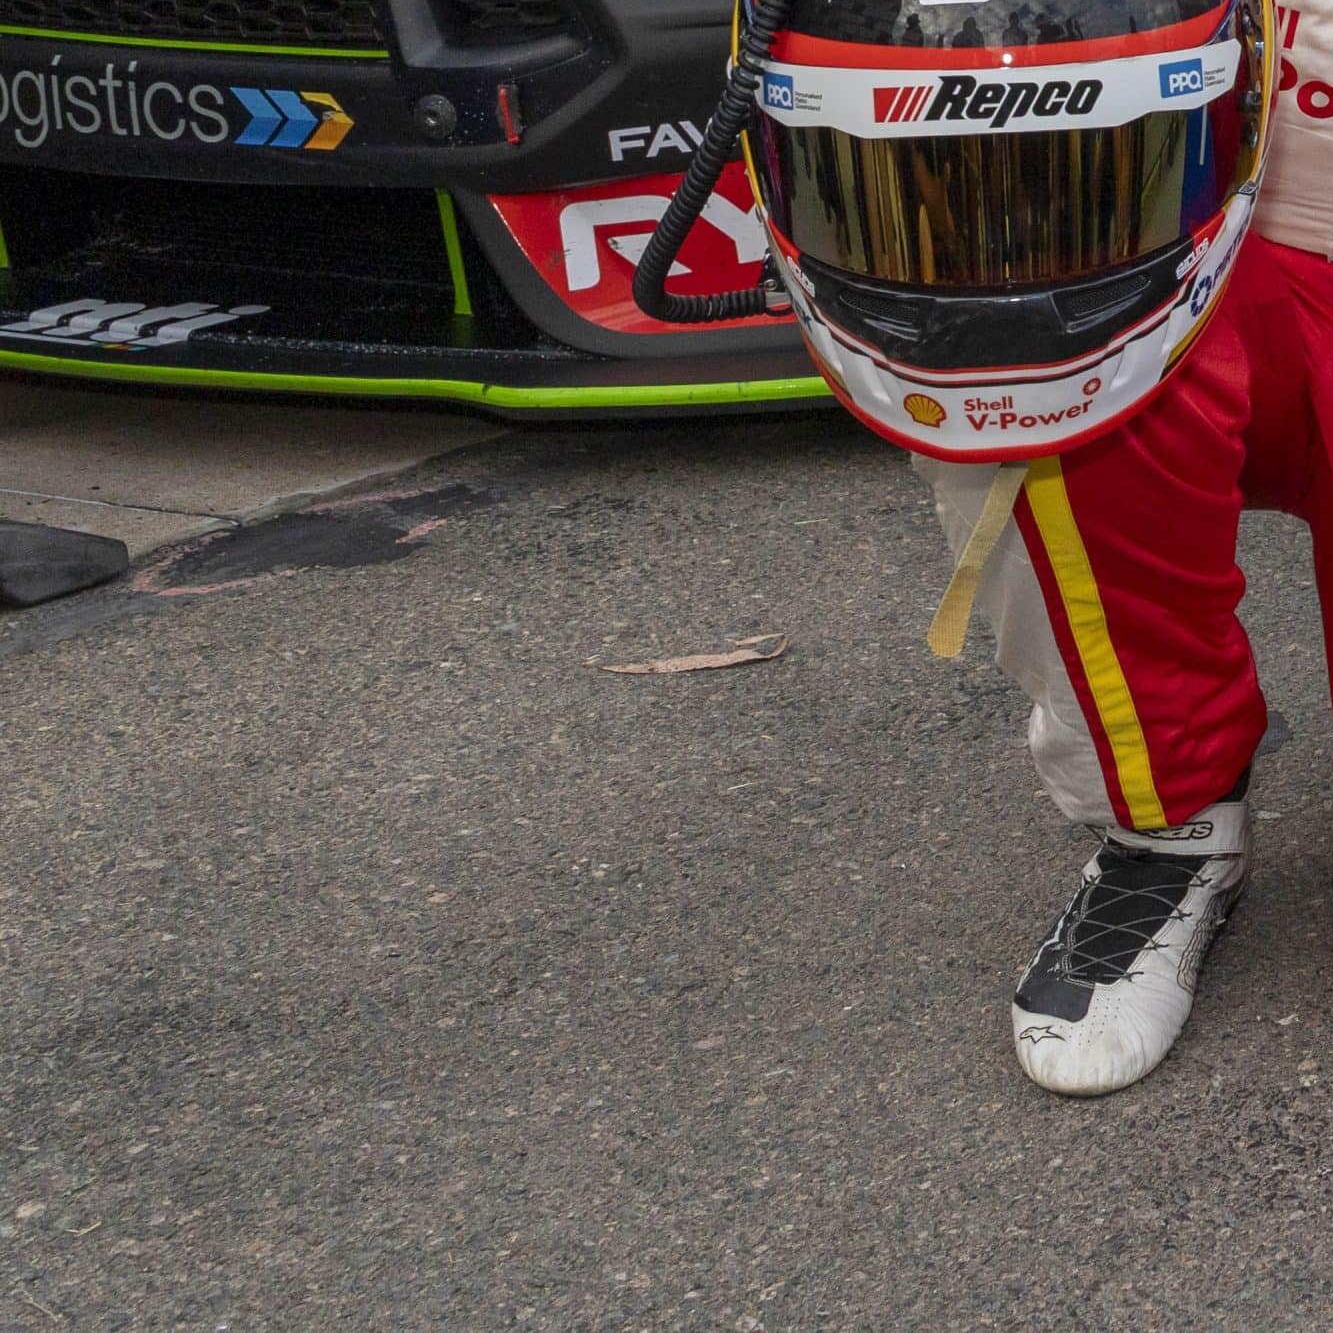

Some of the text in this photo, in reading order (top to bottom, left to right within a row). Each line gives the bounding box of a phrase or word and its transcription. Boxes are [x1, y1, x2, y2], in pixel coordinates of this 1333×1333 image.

[767, 83, 793, 108] PPQ
[1168, 69, 1202, 94] PPQ
[0, 55, 230, 148] gistics
[925, 75, 1103, 129] Repco
[963, 396, 1013, 413] Shell
[965, 398, 1094, 432] V-Power
